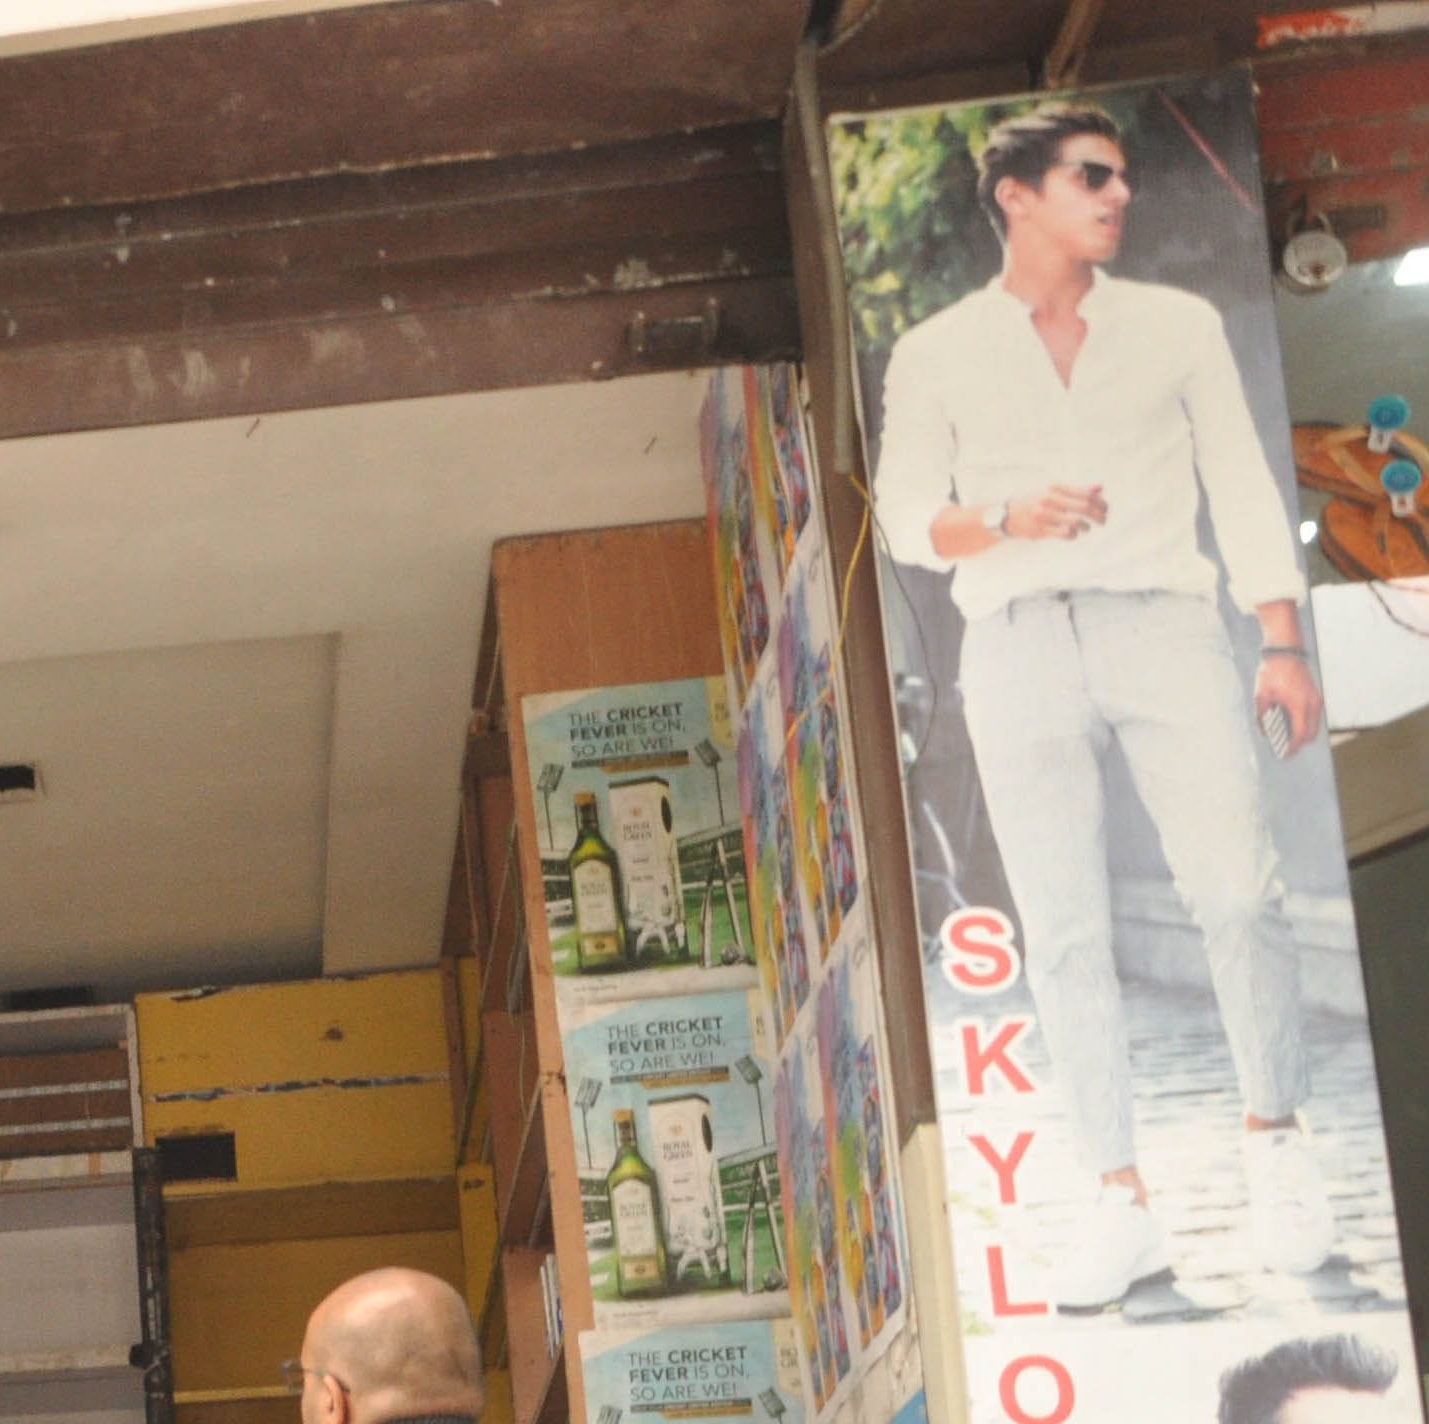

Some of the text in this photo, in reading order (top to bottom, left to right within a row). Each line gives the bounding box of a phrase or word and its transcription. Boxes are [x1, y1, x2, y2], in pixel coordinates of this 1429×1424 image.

[570, 702, 683, 726] THE CRICKET
[570, 724, 627, 741] FEVER
[607, 1016, 724, 1040] THE CRICKET
[608, 1038, 665, 1055] FEVER
[672, 1034, 686, 1048] IS
[610, 1058, 635, 1073] SO
[641, 1055, 671, 1070] ARE
[628, 1346, 747, 1367] THE CRICKET
[629, 1367, 687, 1383] FEVER
[694, 1366, 709, 1380] IS
[630, 1387, 656, 1401] SO
[662, 1384, 693, 1399] ARE
